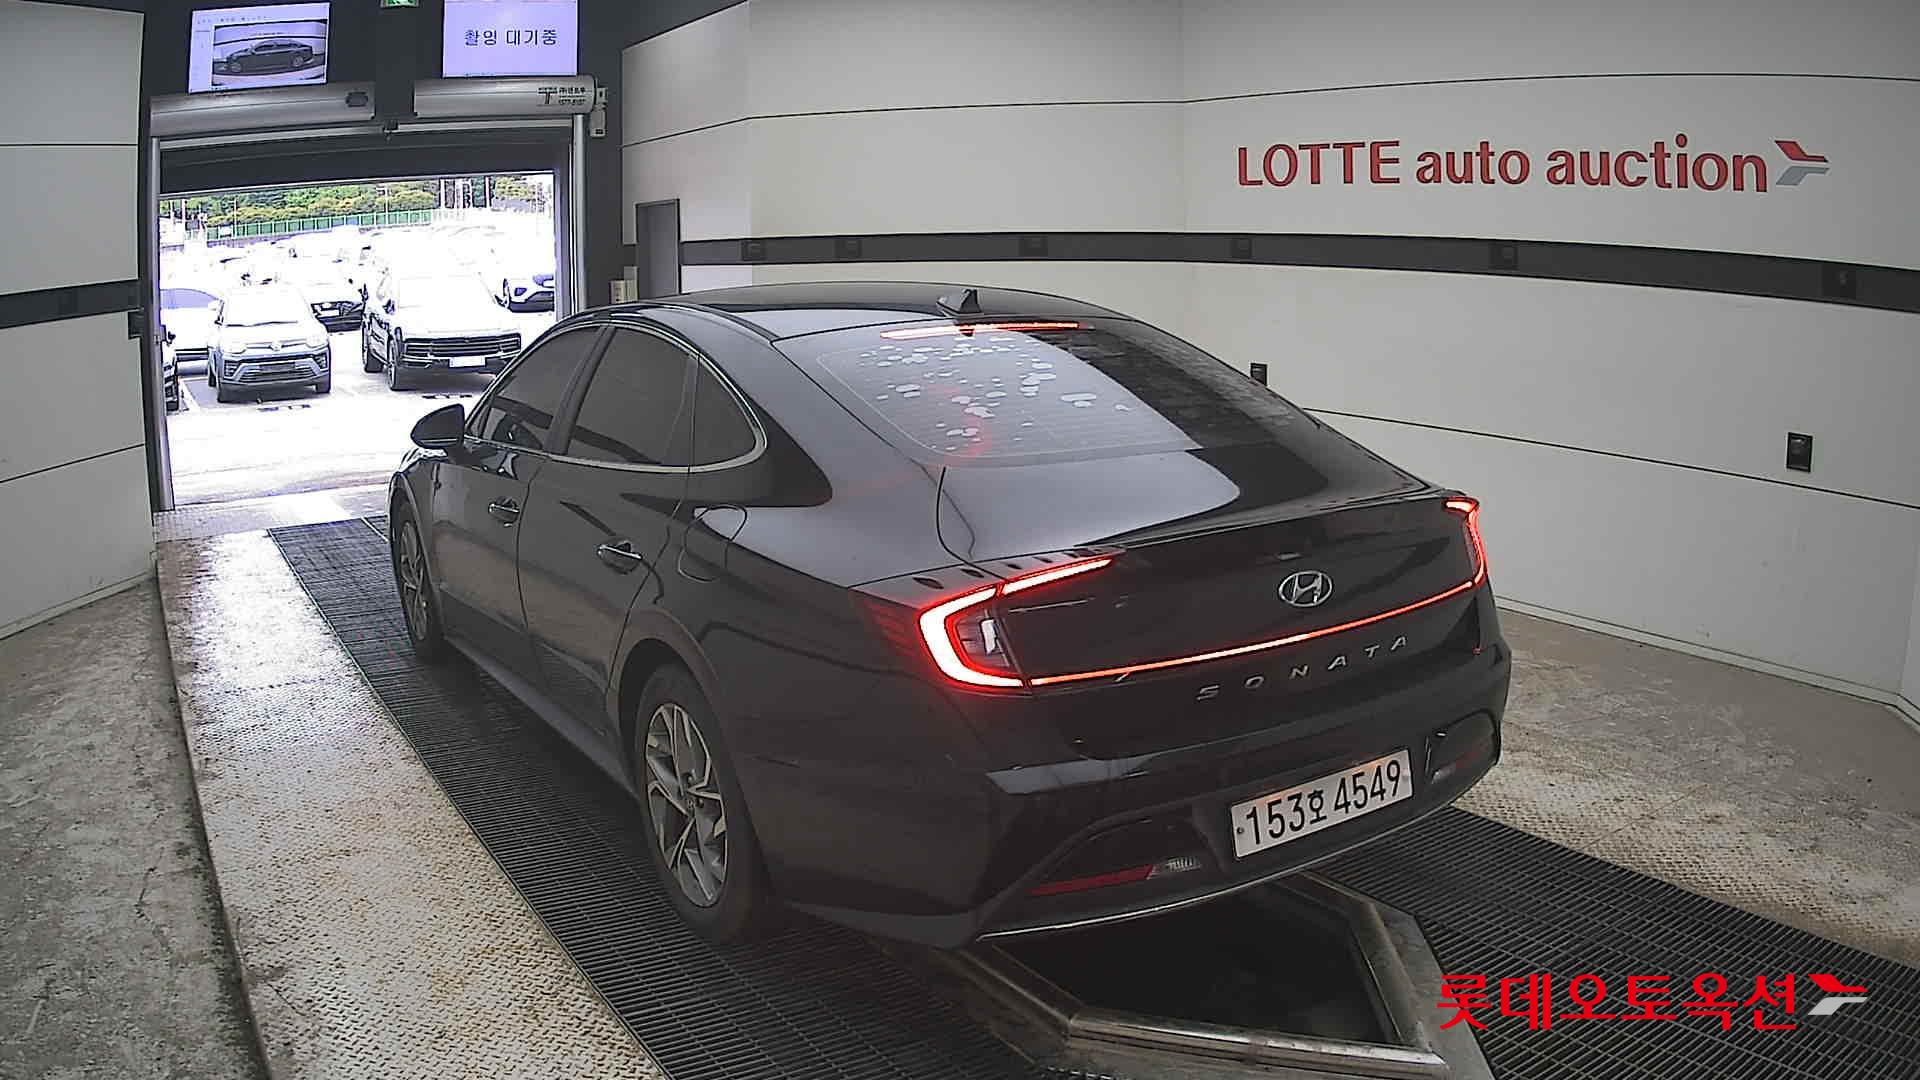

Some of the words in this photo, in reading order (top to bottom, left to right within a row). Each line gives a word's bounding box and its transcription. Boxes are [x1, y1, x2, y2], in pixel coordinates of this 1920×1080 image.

[505, 28, 558, 46] 대기중
[1238, 140, 1400, 187] LOTTE
[1416, 141, 1531, 186] auto
[1546, 134, 1768, 193] auction
[1196, 635, 1407, 701] SONATA
[1246, 788, 1328, 845] 153호
[1333, 759, 1401, 815] 4549
